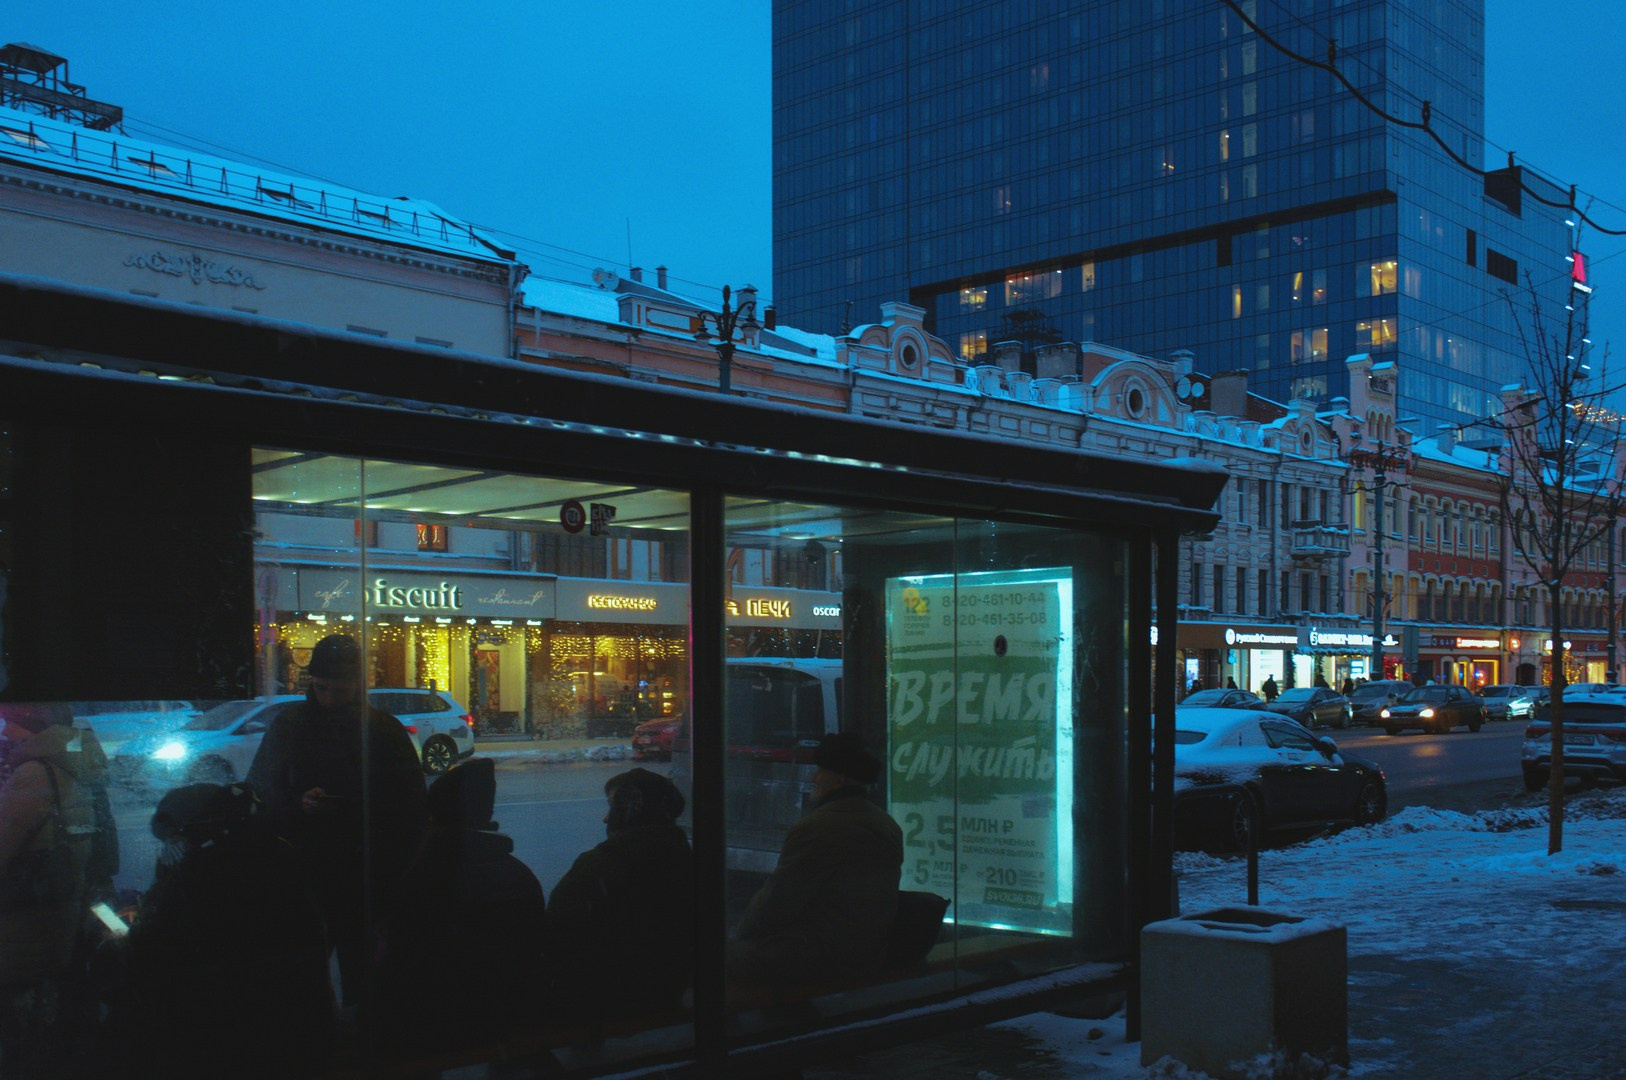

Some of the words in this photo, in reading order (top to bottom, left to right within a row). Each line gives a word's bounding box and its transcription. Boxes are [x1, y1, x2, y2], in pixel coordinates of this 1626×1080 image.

[364, 578, 463, 610] iscuit
[746, 598, 791, 618] ПЕЧИ
[942, 612, 1047, 627] 8-20-461-35-08
[890, 669, 1055, 726] ВРЕМЯ
[904, 812, 955, 857] 2,5
[961, 817, 999, 834] МЛН
[914, 859, 929, 885] 5
[986, 866, 1017, 886] 210
